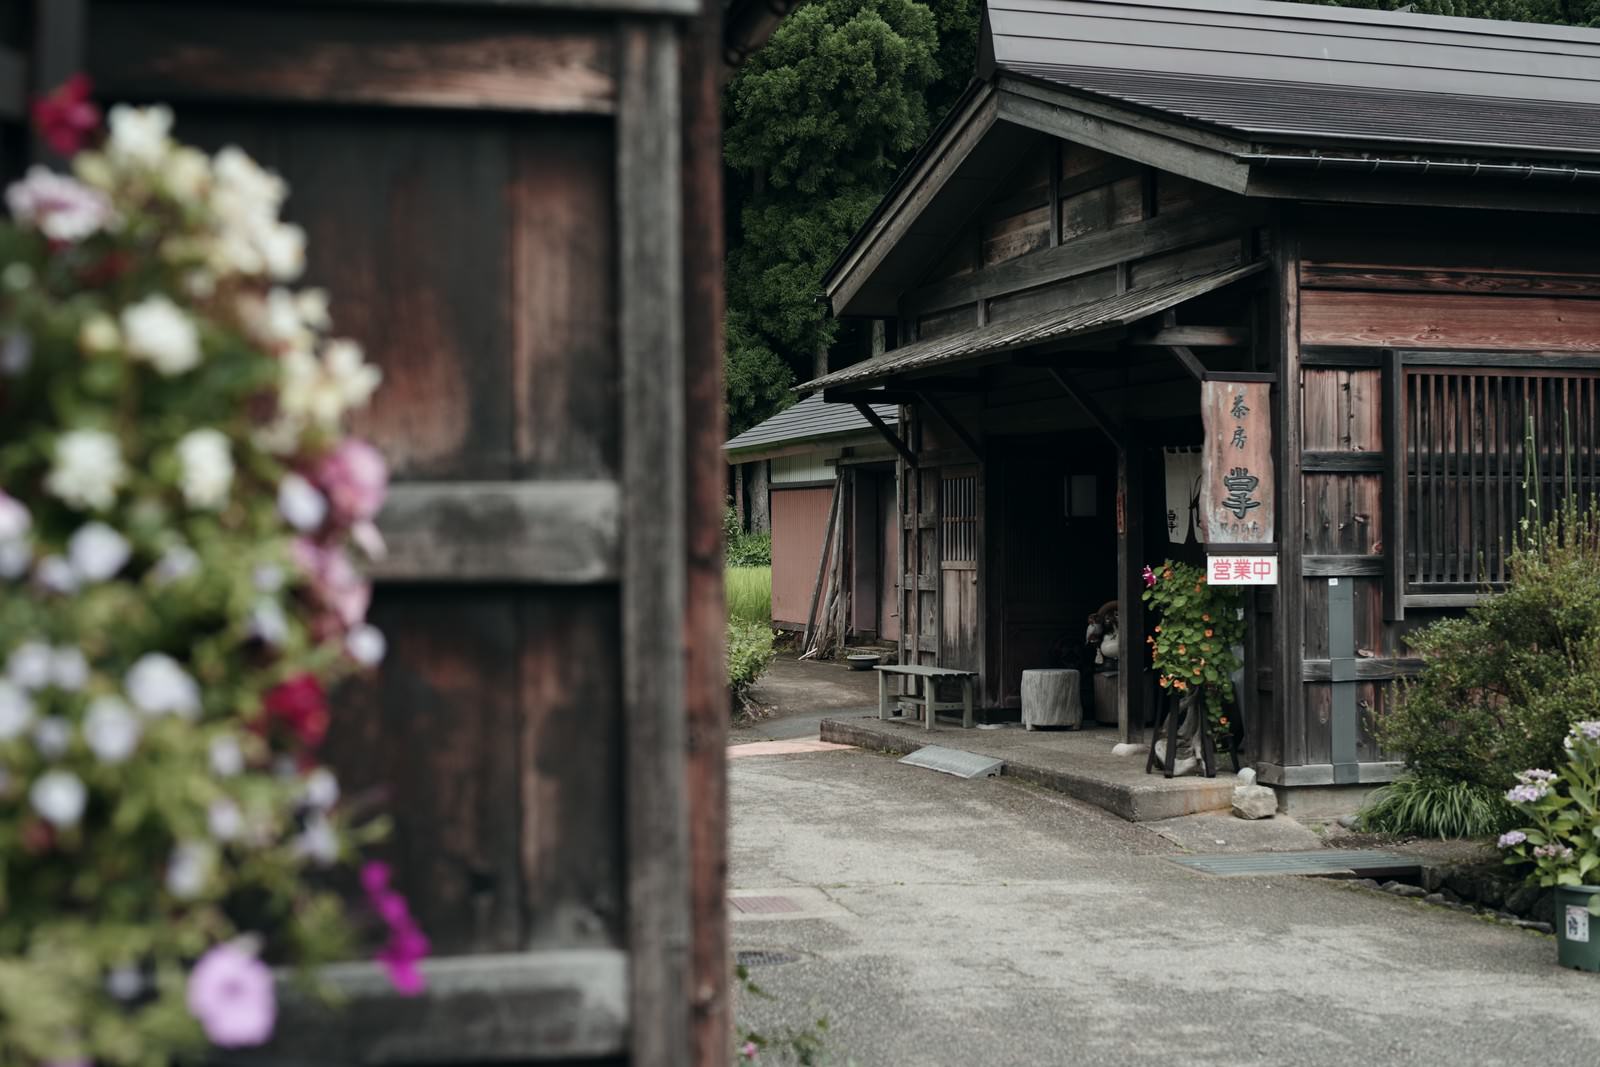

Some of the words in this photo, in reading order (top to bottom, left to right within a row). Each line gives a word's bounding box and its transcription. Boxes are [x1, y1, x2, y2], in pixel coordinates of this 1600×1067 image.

[1230, 394, 1250, 449] 茶房
[1213, 558, 1271, 580] 営業中
